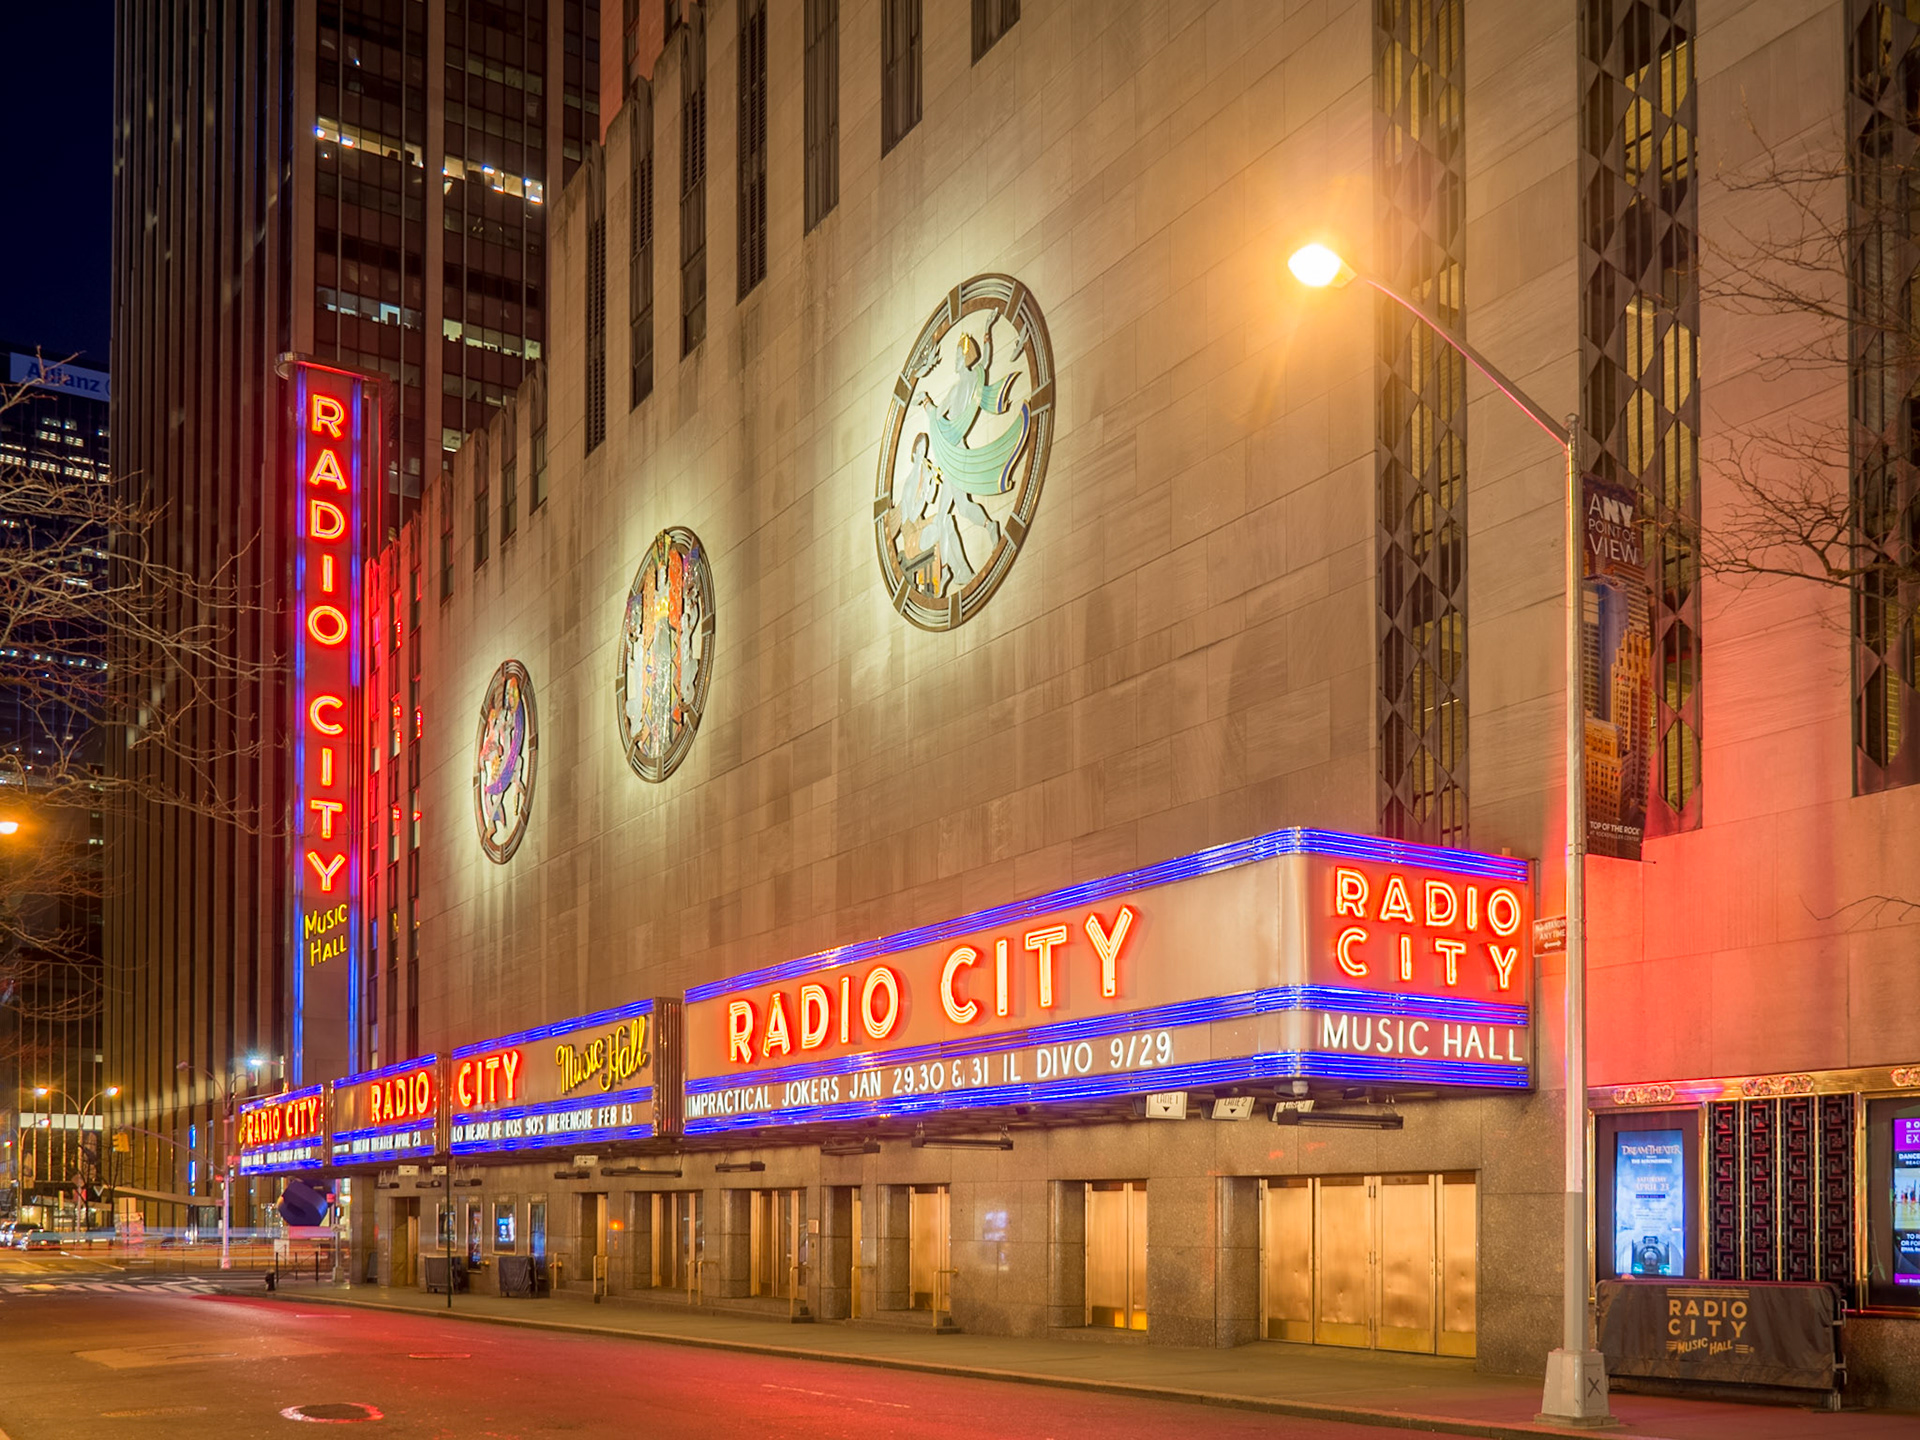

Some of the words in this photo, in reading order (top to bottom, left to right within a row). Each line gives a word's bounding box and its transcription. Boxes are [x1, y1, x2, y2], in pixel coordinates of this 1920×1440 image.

[307, 393, 348, 646] RADIO
[1589, 493, 1634, 528] ANY
[1589, 518, 1621, 538] POINT
[1622, 529, 1636, 543] OF
[1589, 533, 1637, 565] VIEW
[307, 695, 346, 892] CITY
[1590, 821, 1601, 829] TOP
[1602, 823, 1610, 831] OF
[1610, 824, 1623, 833] THE
[1624, 826, 1640, 835] ROCK
[1336, 867, 1521, 936] RADIO
[1337, 927, 1518, 990] CITY
[728, 966, 899, 1064] RADIO
[940, 905, 1134, 1024] CITY
[599, 1015, 648, 1092] Hall
[1323, 1013, 1430, 1056] MUSIC
[1443, 1023, 1523, 1062] HALL
[371, 1070, 430, 1122] RADIO
[457, 1050, 519, 1107] CITY
[689, 1085, 771, 1118] IMPRACTICAL
[782, 1076, 840, 1107] JOKERS
[849, 1070, 883, 1099] JAN
[971, 1056, 989, 1085] 31
[1003, 1053, 1021, 1083] IL
[1036, 1042, 1093, 1080] DIVO
[1109, 1031, 1173, 1069] 9/29
[247, 1108, 281, 1144] RADIO
[285, 1097, 318, 1137] CITY
[452, 1126, 463, 1143] LO
[465, 1123, 490, 1141] MEJOR
[492, 1121, 502, 1139] DE
[505, 1118, 522, 1137] LOS
[547, 1108, 593, 1134] MERENGUE
[598, 1105, 617, 1127] FEB
[1668, 1319, 1747, 1338] CITY
[1669, 1299, 1748, 1318] RADIO
[1677, 1336, 1708, 1354] MUSIC
[1709, 1339, 1733, 1355] HALL
